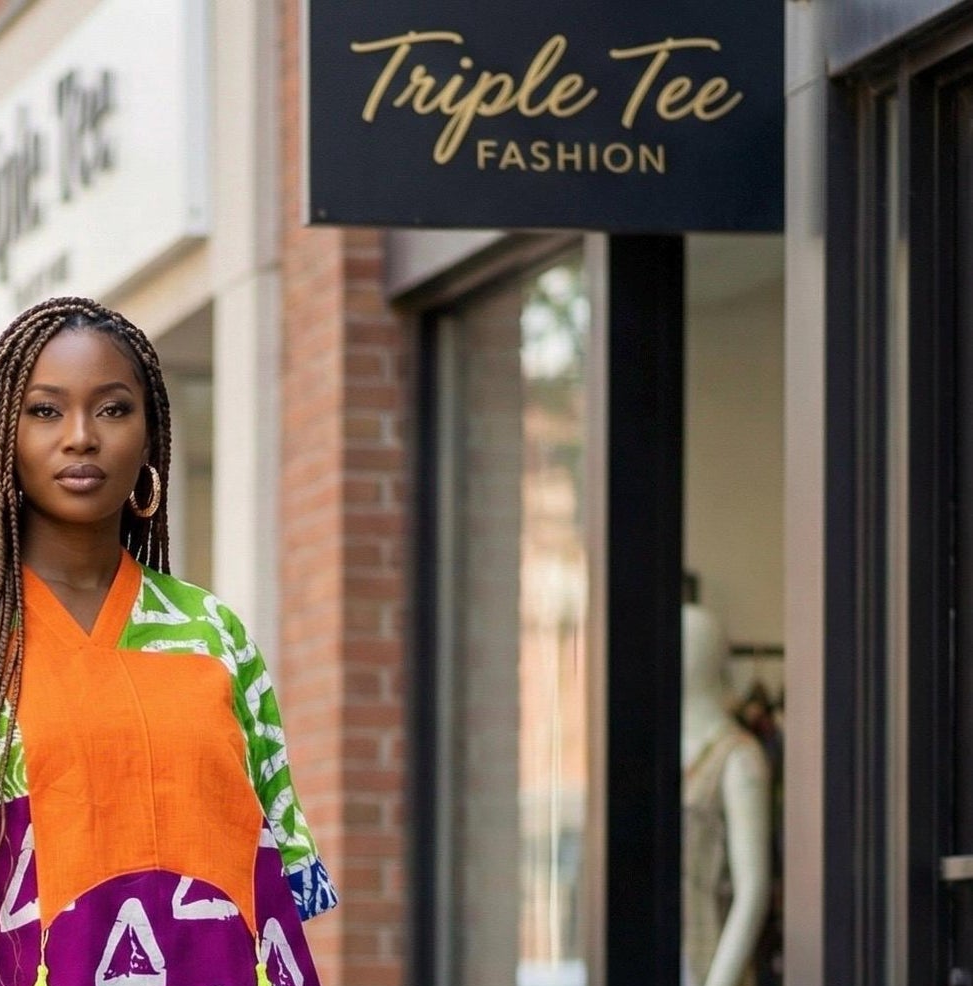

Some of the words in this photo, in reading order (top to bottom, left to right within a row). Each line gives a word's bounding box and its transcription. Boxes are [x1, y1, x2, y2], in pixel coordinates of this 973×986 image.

[350, 31, 598, 165] Triple
[609, 38, 743, 129] Tee
[477, 140, 665, 172] FASHION
